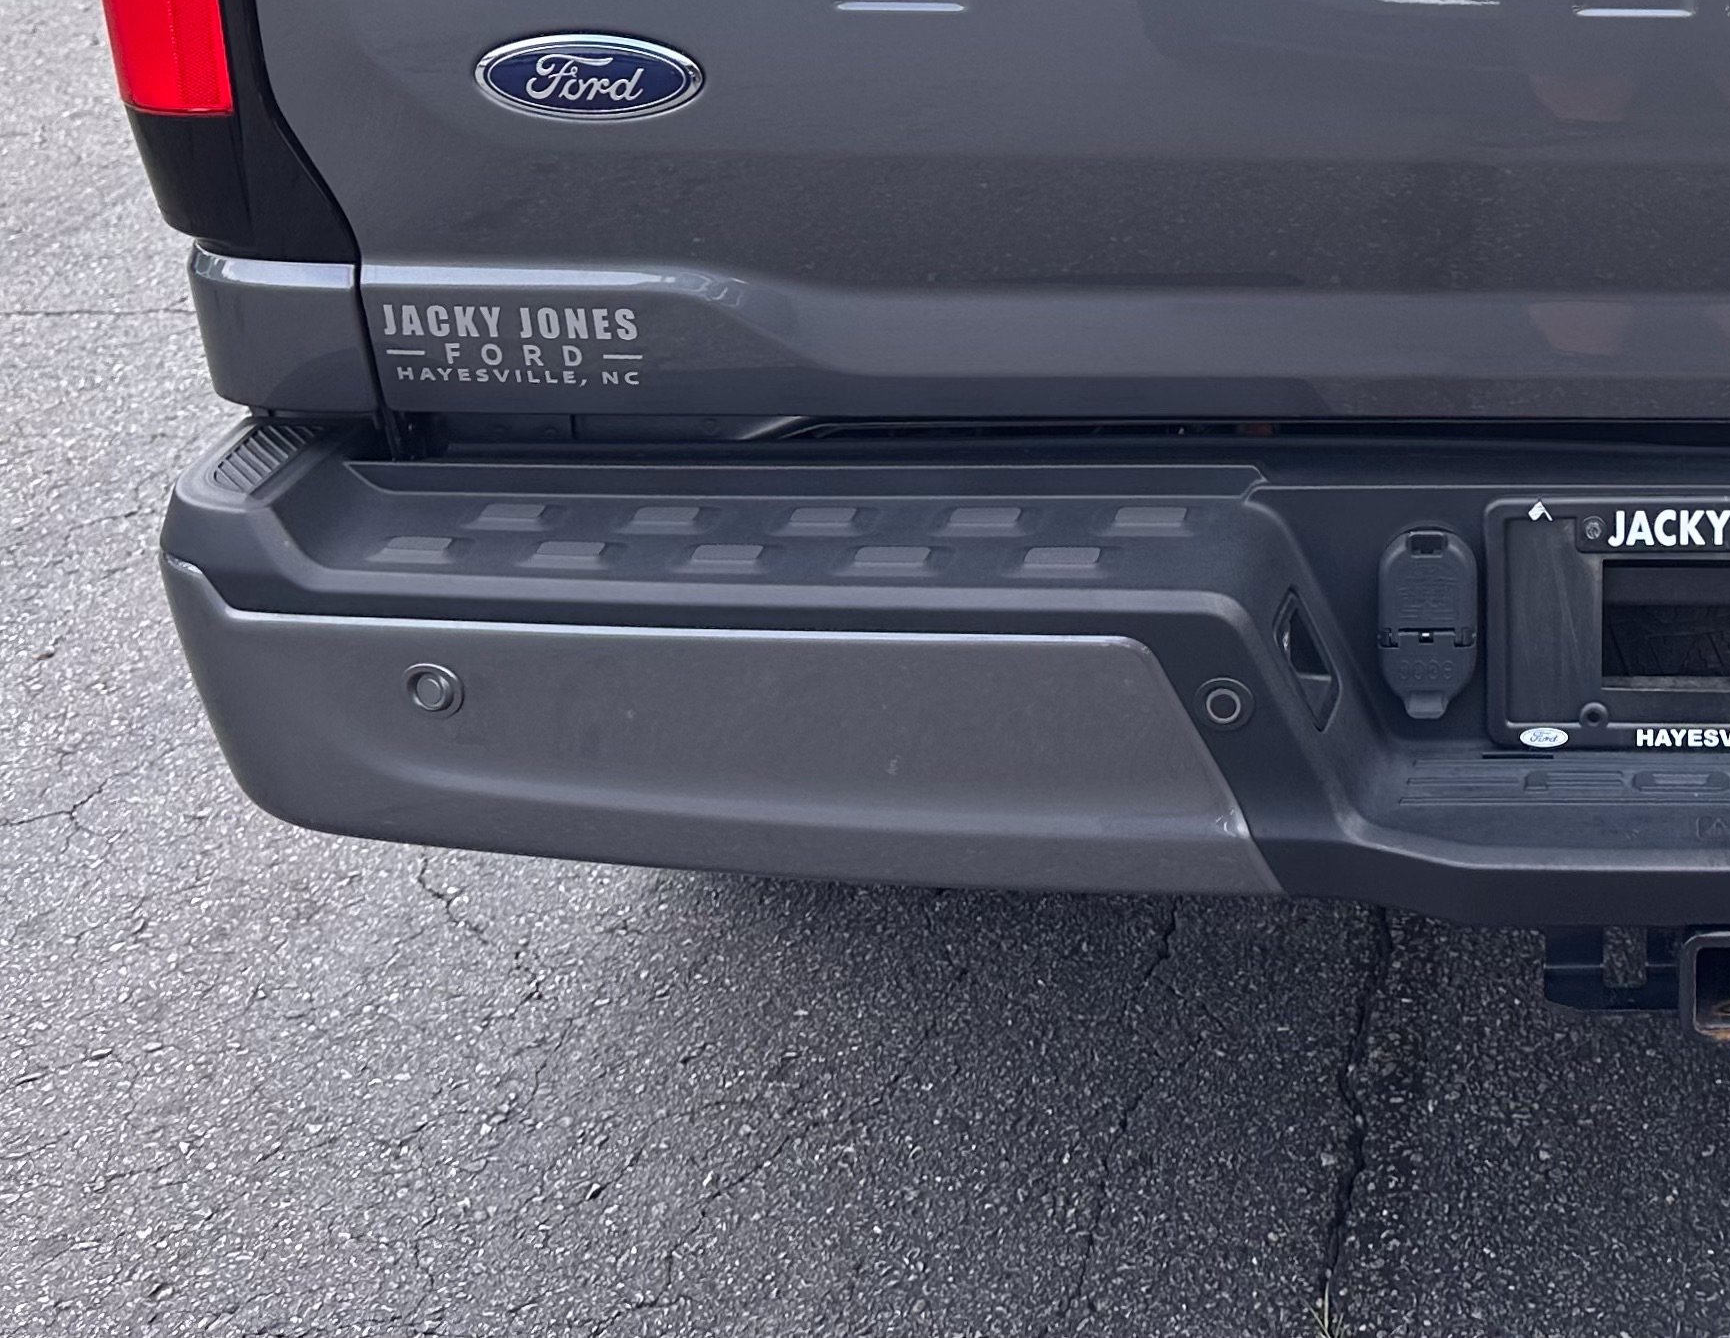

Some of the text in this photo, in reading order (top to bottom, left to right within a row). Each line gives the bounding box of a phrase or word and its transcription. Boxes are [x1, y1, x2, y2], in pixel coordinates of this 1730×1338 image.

[525, 53, 646, 101] Ford
[383, 304, 639, 341] JACKY JONES
[445, 342, 583, 367] FORD
[396, 366, 640, 387] HAYESVILLE, NC
